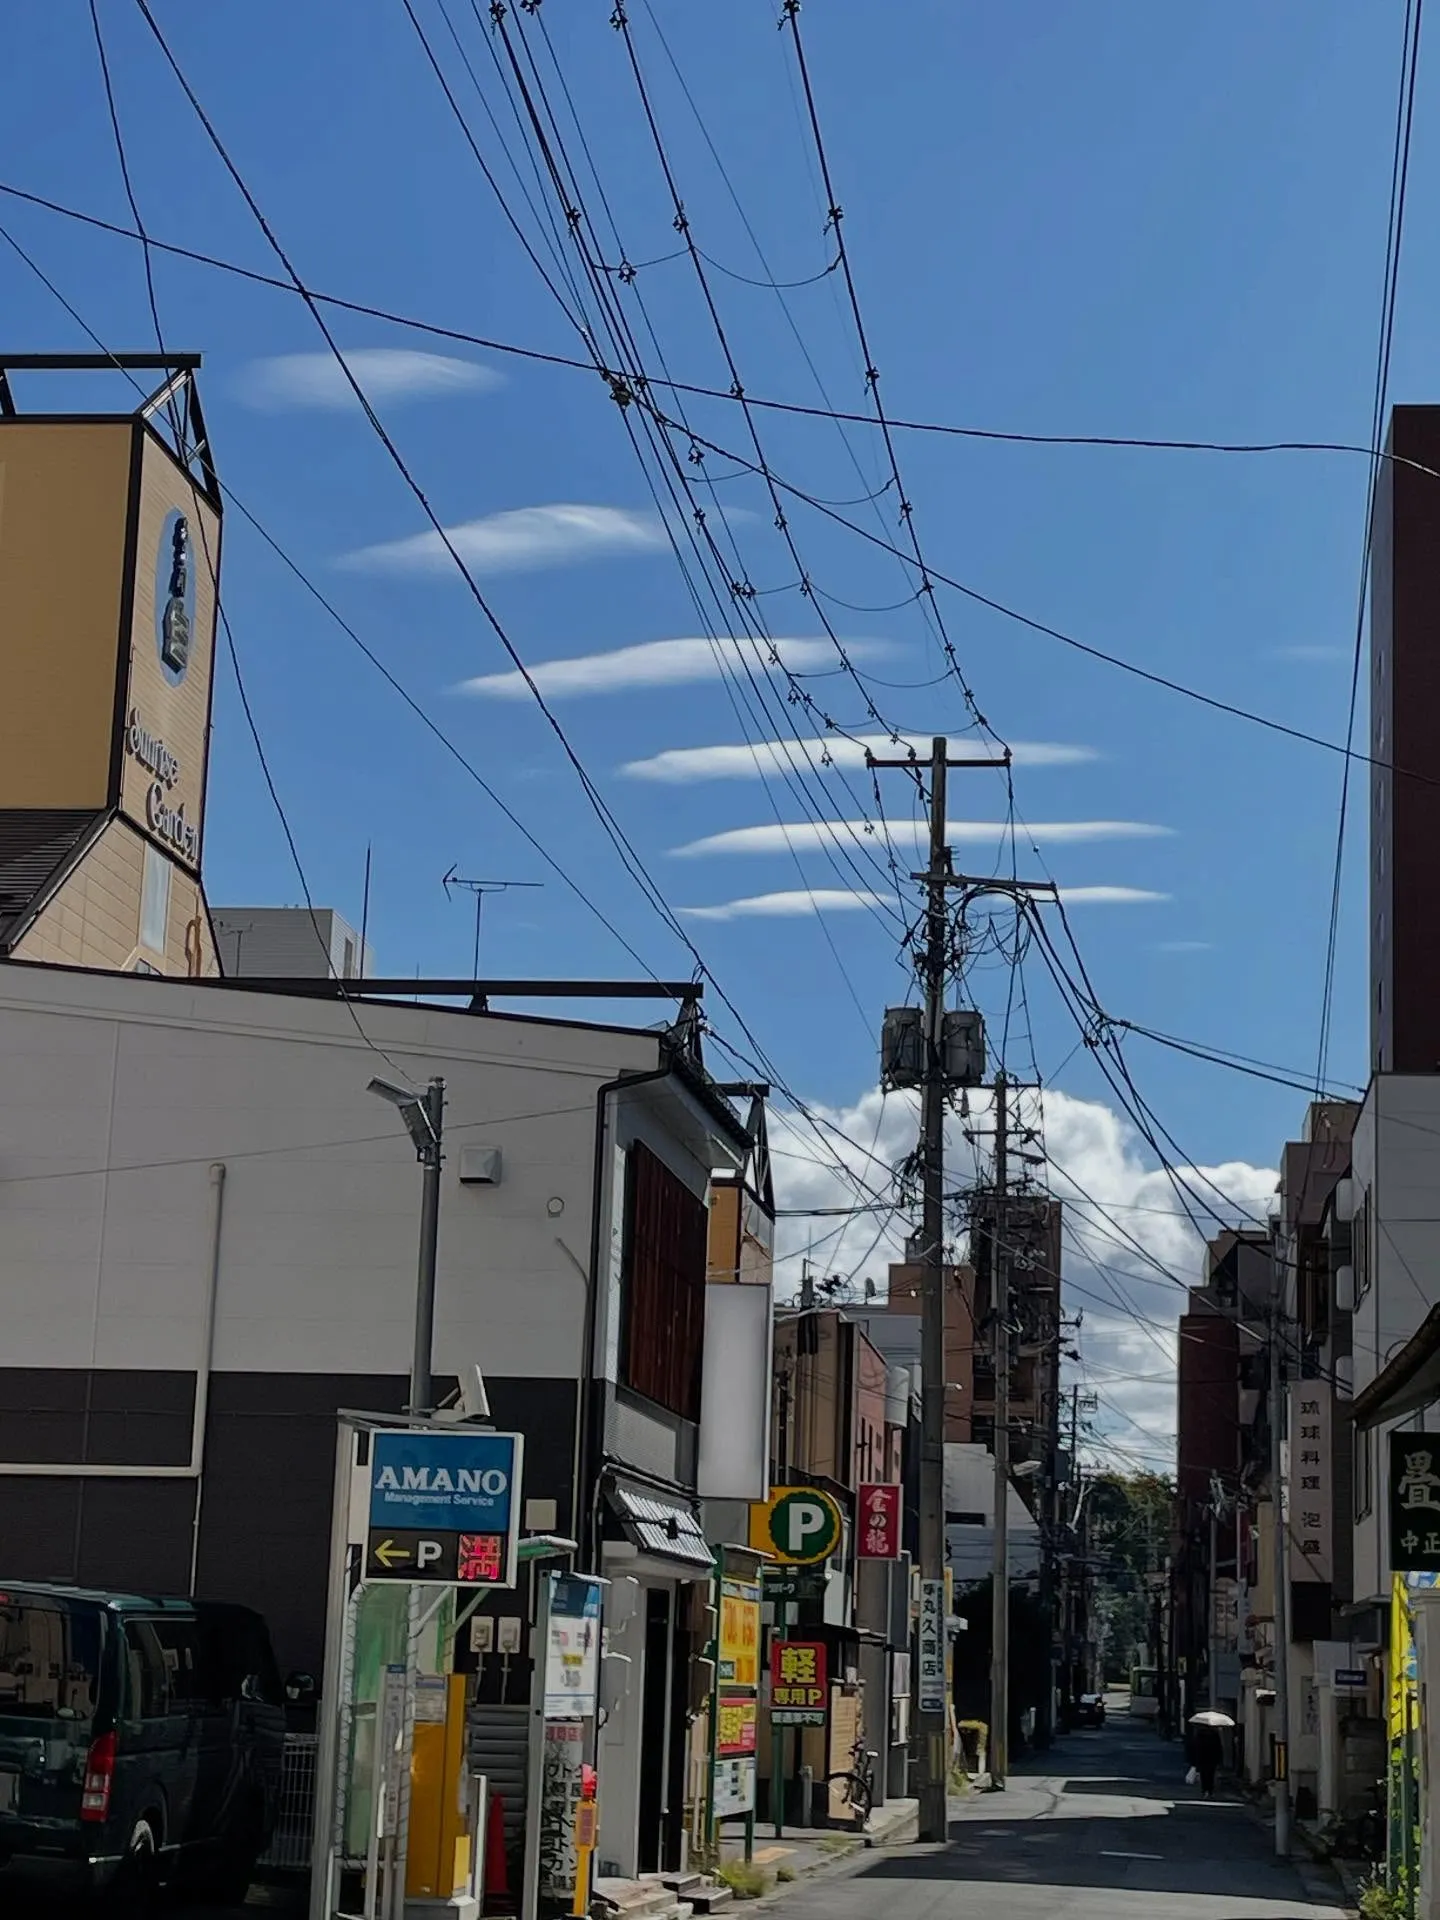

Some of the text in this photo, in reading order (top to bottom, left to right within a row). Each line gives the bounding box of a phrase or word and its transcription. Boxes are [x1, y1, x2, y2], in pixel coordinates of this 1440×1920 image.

[147, 782, 199, 862] Garden
[374, 1465, 508, 1496] AMANO
[1300, 1401, 1322, 1555] 琉球料理 泡盛
[1398, 1450, 1440, 1512] 畳
[384, 1491, 494, 1507] Management Service
[788, 1502, 826, 1551] P
[417, 1540, 443, 1569] P
[458, 1534, 502, 1580] 満
[780, 1647, 816, 1684] 軽
[773, 1687, 823, 1706] 専用P
